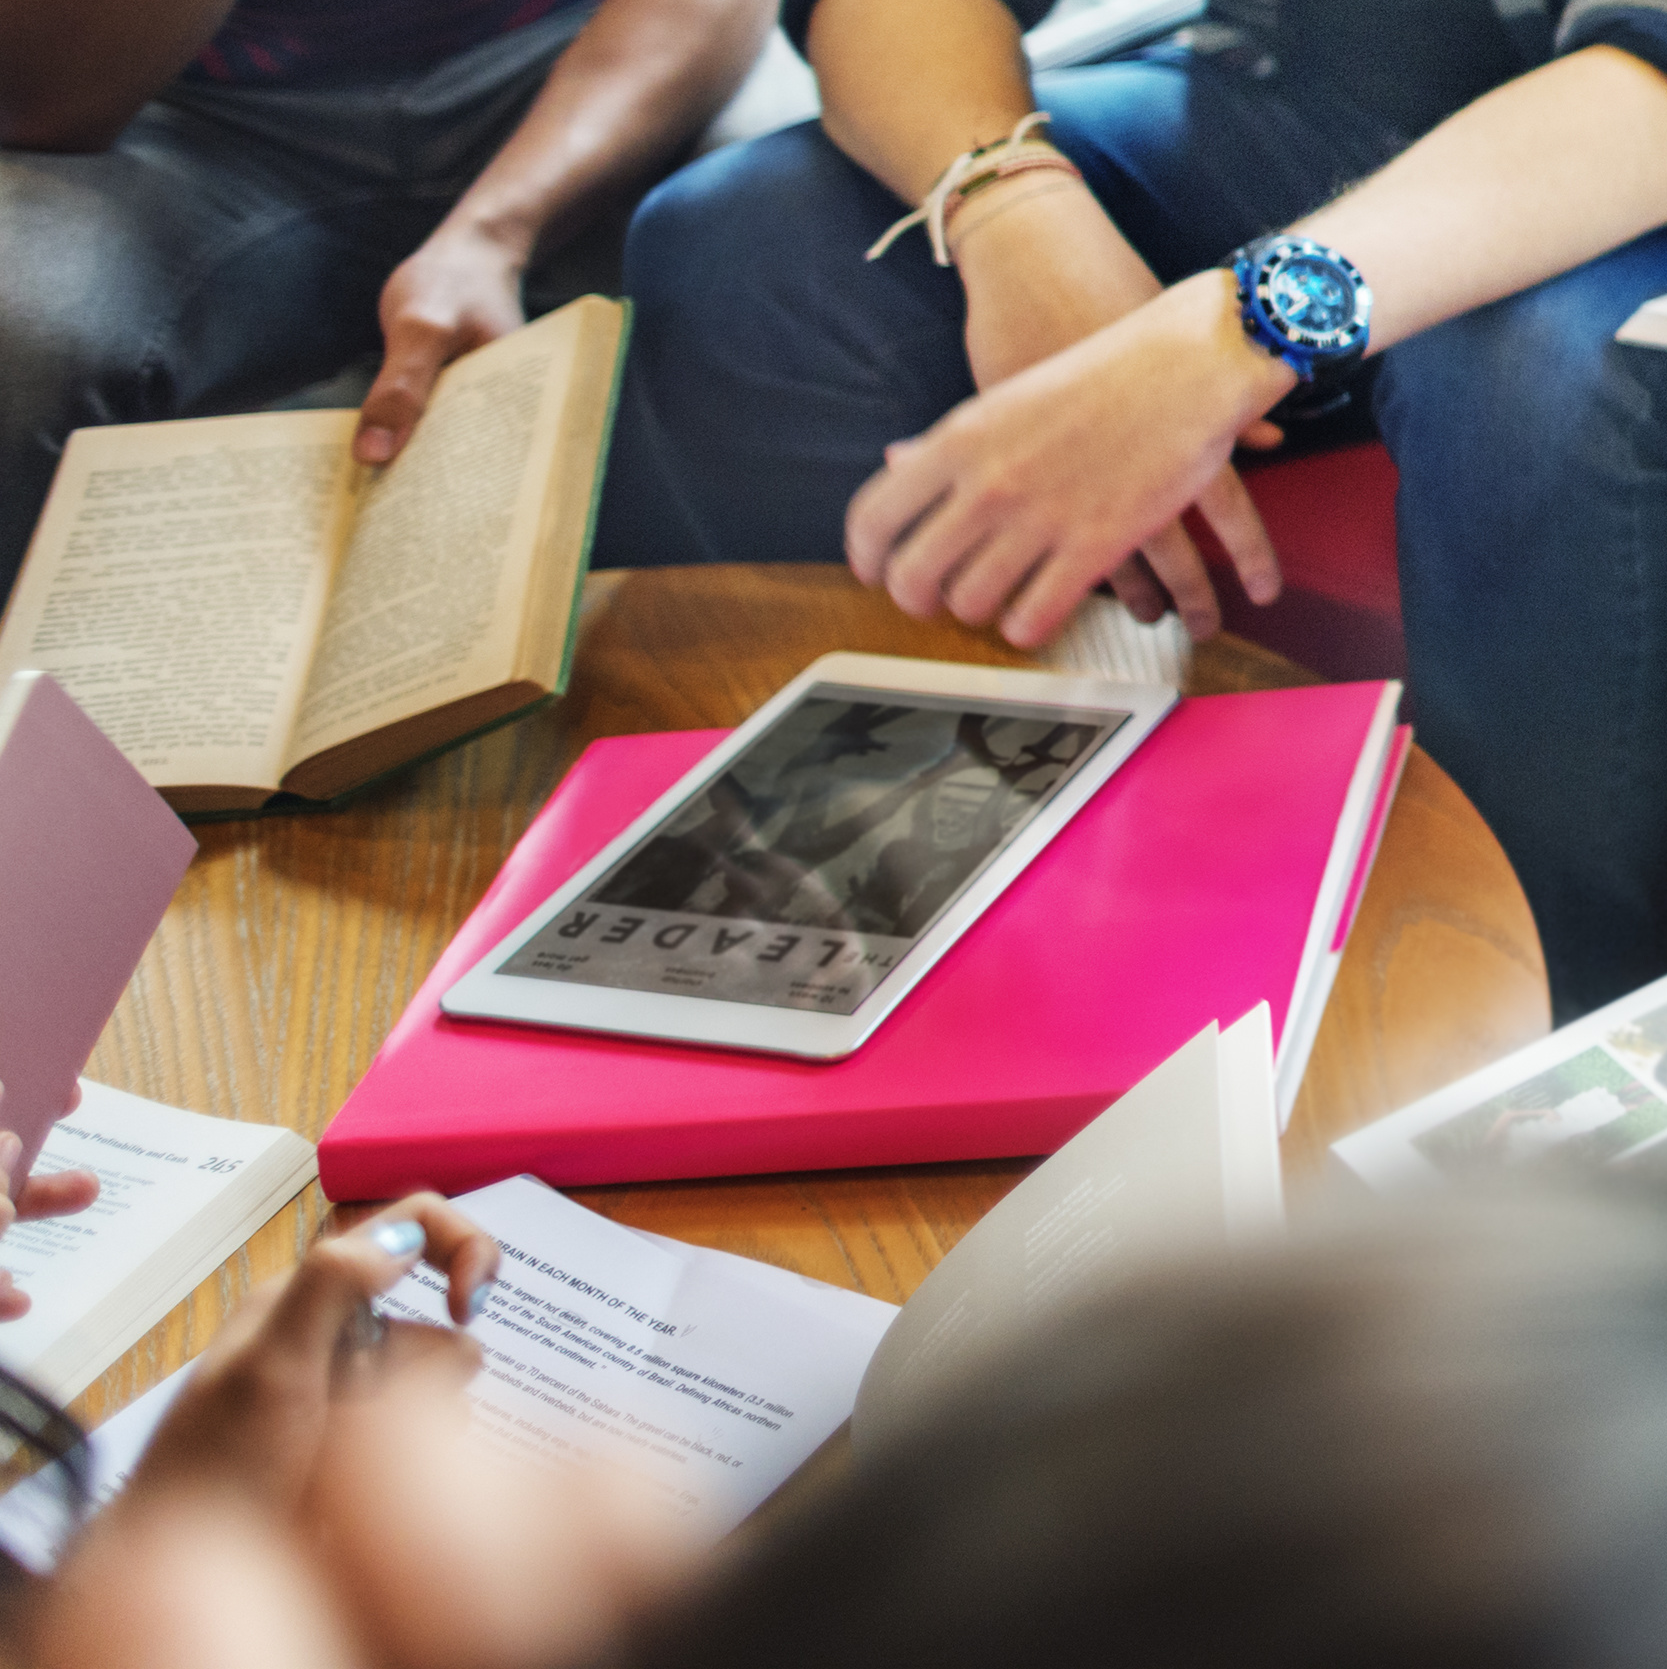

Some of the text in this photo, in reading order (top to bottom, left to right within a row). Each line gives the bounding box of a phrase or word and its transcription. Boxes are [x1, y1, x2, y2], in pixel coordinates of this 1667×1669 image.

[557, 912, 847, 968] LEADER
[52, 1119, 188, 1163] anaging Profitability and Cash
[197, 1156, 243, 1173] 245
[524, 1256, 540, 1267] IN
[536, 1262, 570, 1282] EACH
[567, 1277, 608, 1301] MONTH
[606, 1297, 626, 1308] OF
[624, 1305, 648, 1322] THE
[647, 1318, 677, 1336] YEAR.
[486, 1310, 501, 1323] 25
[495, 1313, 532, 1337] percent
[529, 1330, 544, 1343] of
[539, 1334, 555, 1348] the
[554, 1345, 597, 1368] continent.
[490, 1294, 508, 1307] size
[508, 1304, 523, 1315] of
[519, 1309, 535, 1320] the
[534, 1316, 561, 1333] South
[560, 1329, 602, 1353] American
[601, 1351, 636, 1371] country
[636, 1369, 651, 1377] of
[646, 1370, 675, 1387] Brazil.
[674, 1383, 712, 1404] Defining
[711, 1398, 743, 1415] Africas
[742, 1411, 782, 1431] northern
[491, 1277, 512, 1290] orlds
[512, 1287, 544, 1306] largest
[542, 1301, 560, 1314] hot
[558, 1311, 587, 1328] desert,
[588, 1326, 627, 1349] covering
[641, 1353, 671, 1369] million
[670, 1365, 701, 1381] square
[700, 1376, 745, 1398] kilometers
[743, 1394, 765, 1405] (3.3
[762, 1402, 794, 1418] million
[381, 1291, 409, 1316] plains
[406, 1308, 420, 1320] of
[492, 1351, 515, 1365] make
[513, 1361, 527, 1371] up
[526, 1365, 539, 1376] 70
[534, 1369, 569, 1392] percent
[566, 1387, 580, 1399] of
[575, 1391, 591, 1403] the
[689, 1441, 713, 1458] black,
[488, 1368, 523, 1388] seabeds
[521, 1384, 540, 1396] and
[537, 1392, 576, 1416] riverbeds,
[576, 1410, 594, 1423] but
